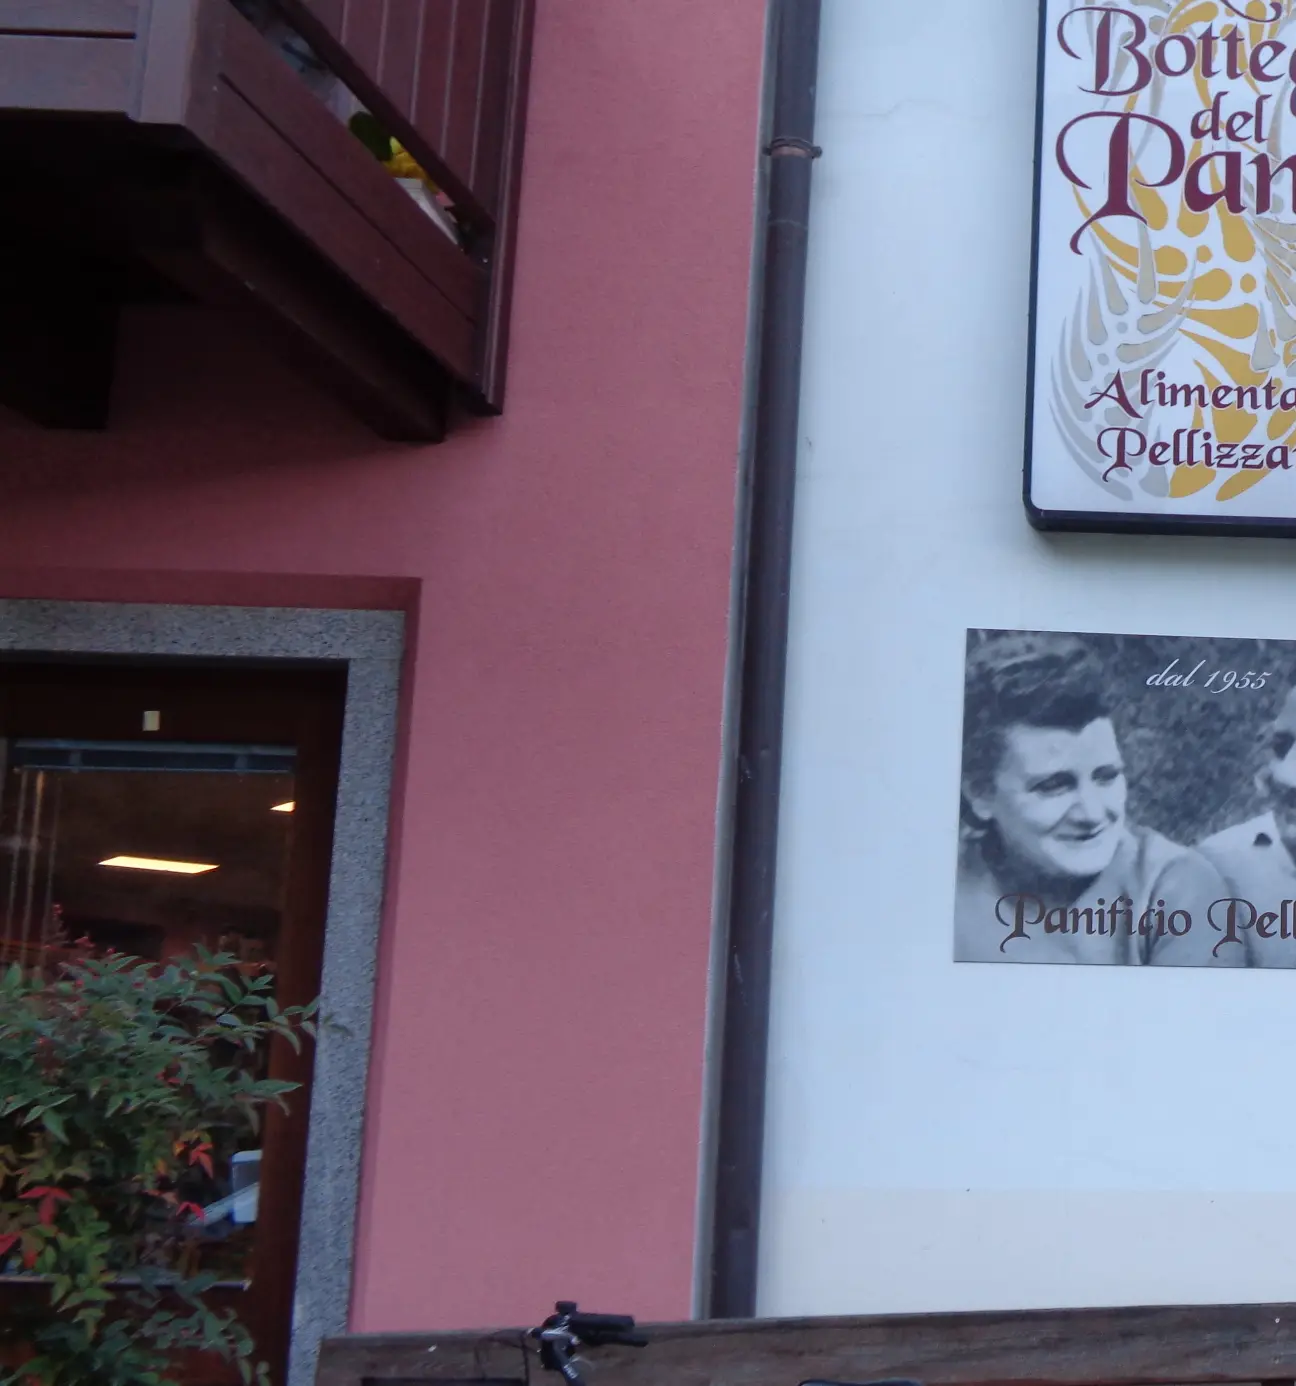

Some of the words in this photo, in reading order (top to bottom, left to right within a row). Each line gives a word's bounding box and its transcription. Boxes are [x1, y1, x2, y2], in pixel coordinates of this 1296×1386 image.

[1190, 91, 1273, 143] del
[1145, 658, 1206, 689] dal
[1202, 669, 1273, 694] 1955
[994, 893, 1193, 953] Panificio
